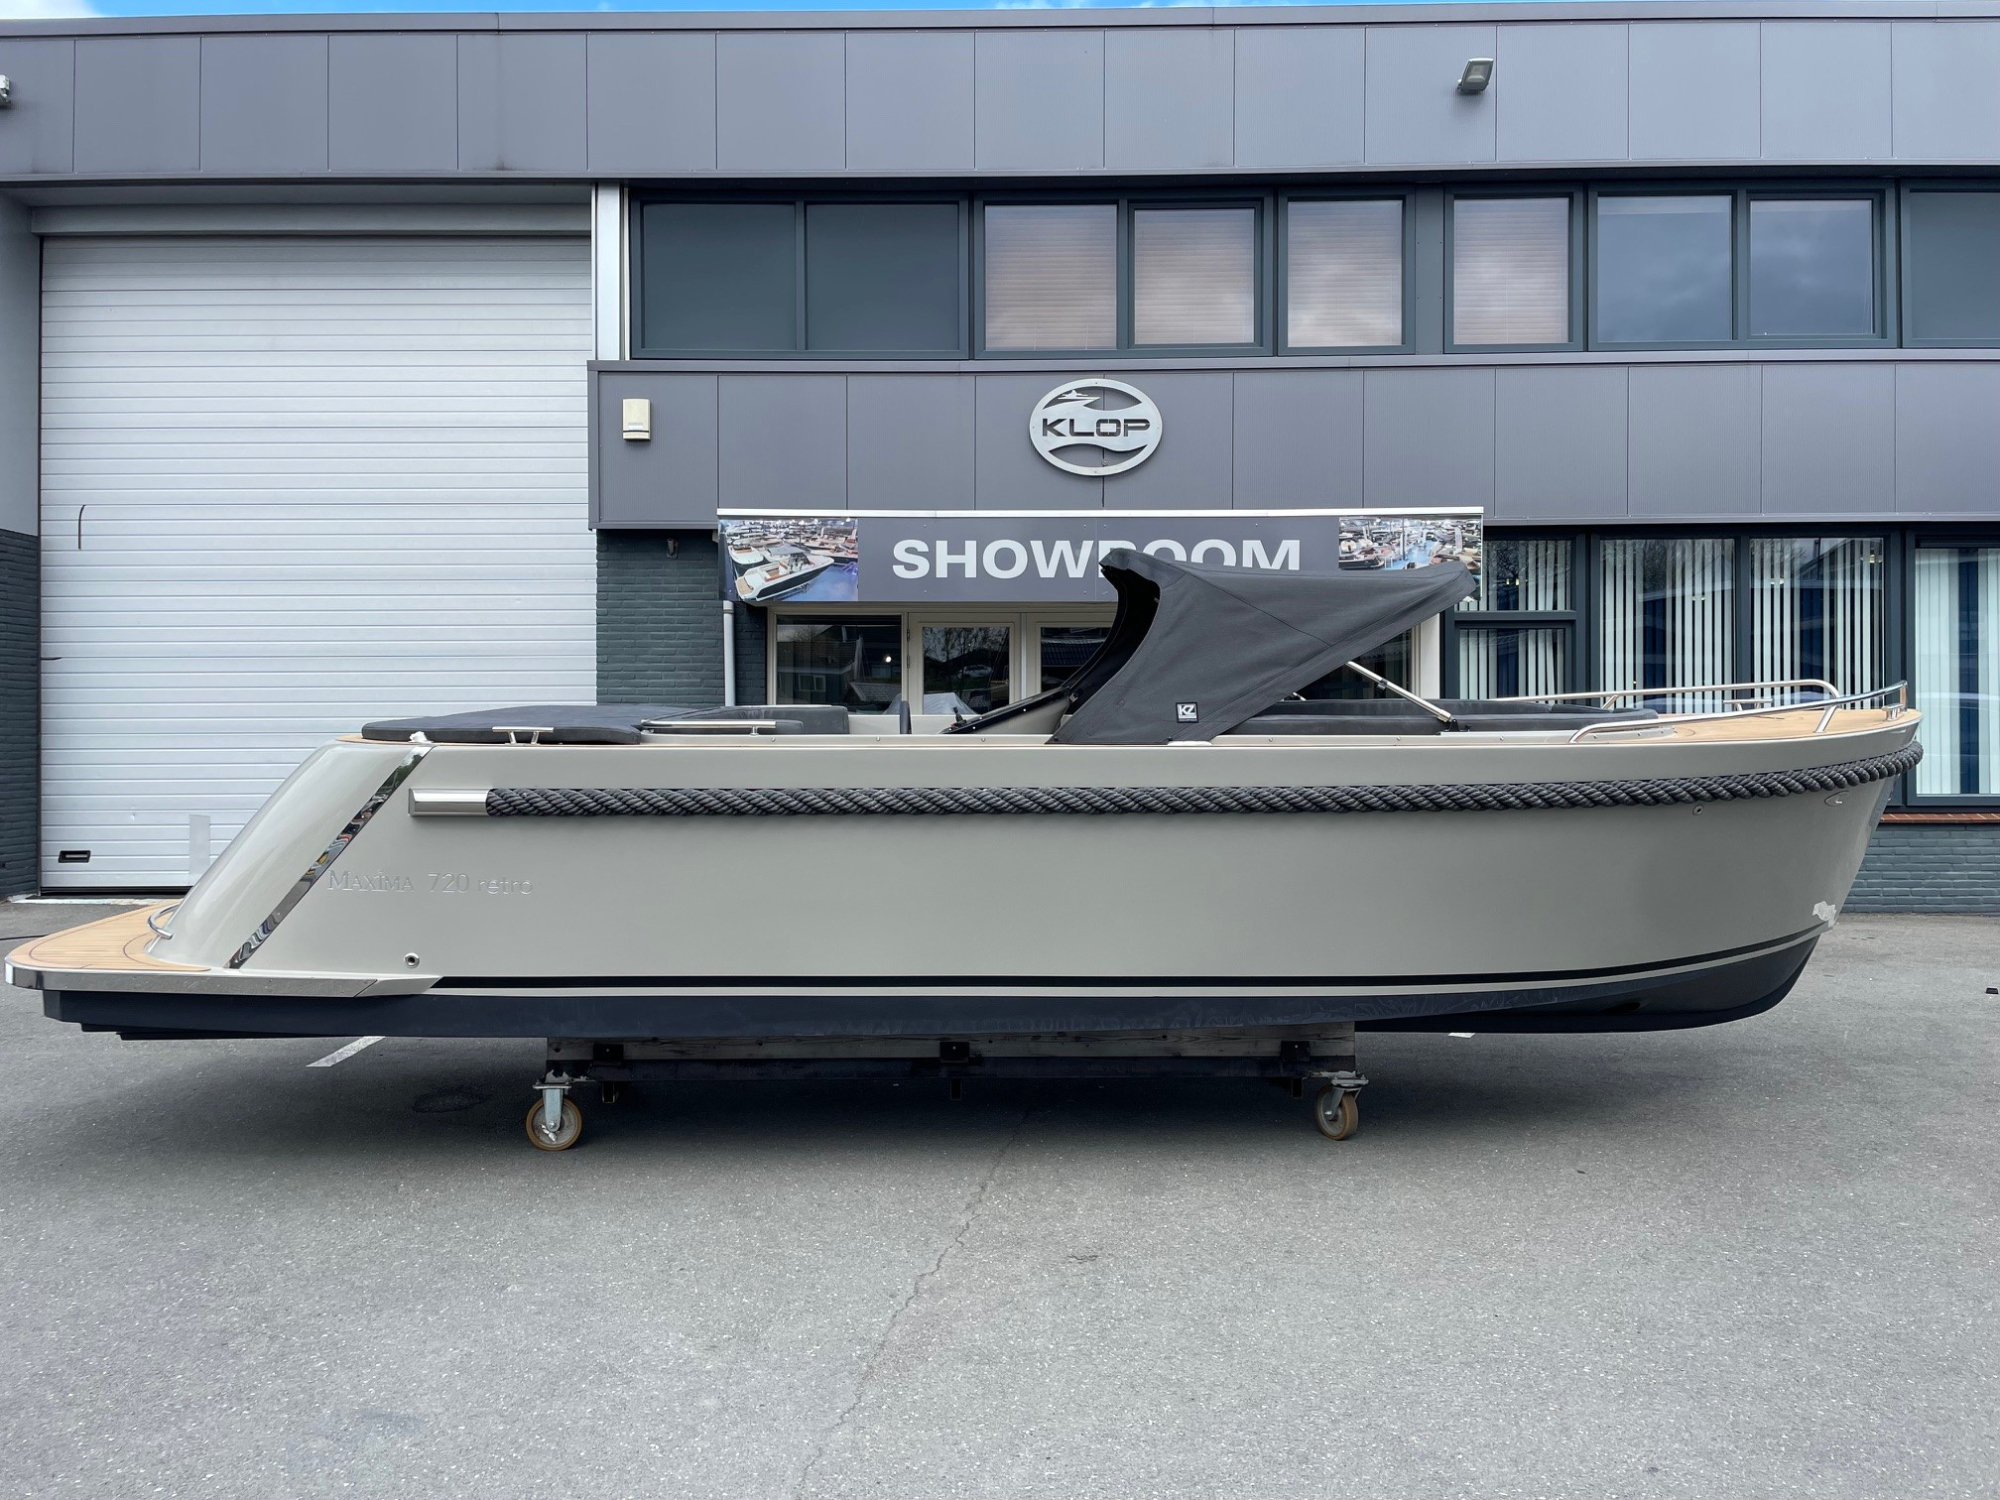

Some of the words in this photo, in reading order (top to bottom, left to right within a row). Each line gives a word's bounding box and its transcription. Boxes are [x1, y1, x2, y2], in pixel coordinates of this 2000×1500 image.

[1042, 418, 1150, 437] KLOP
[428, 872, 470, 893] 720
[478, 877, 533, 895] retro
